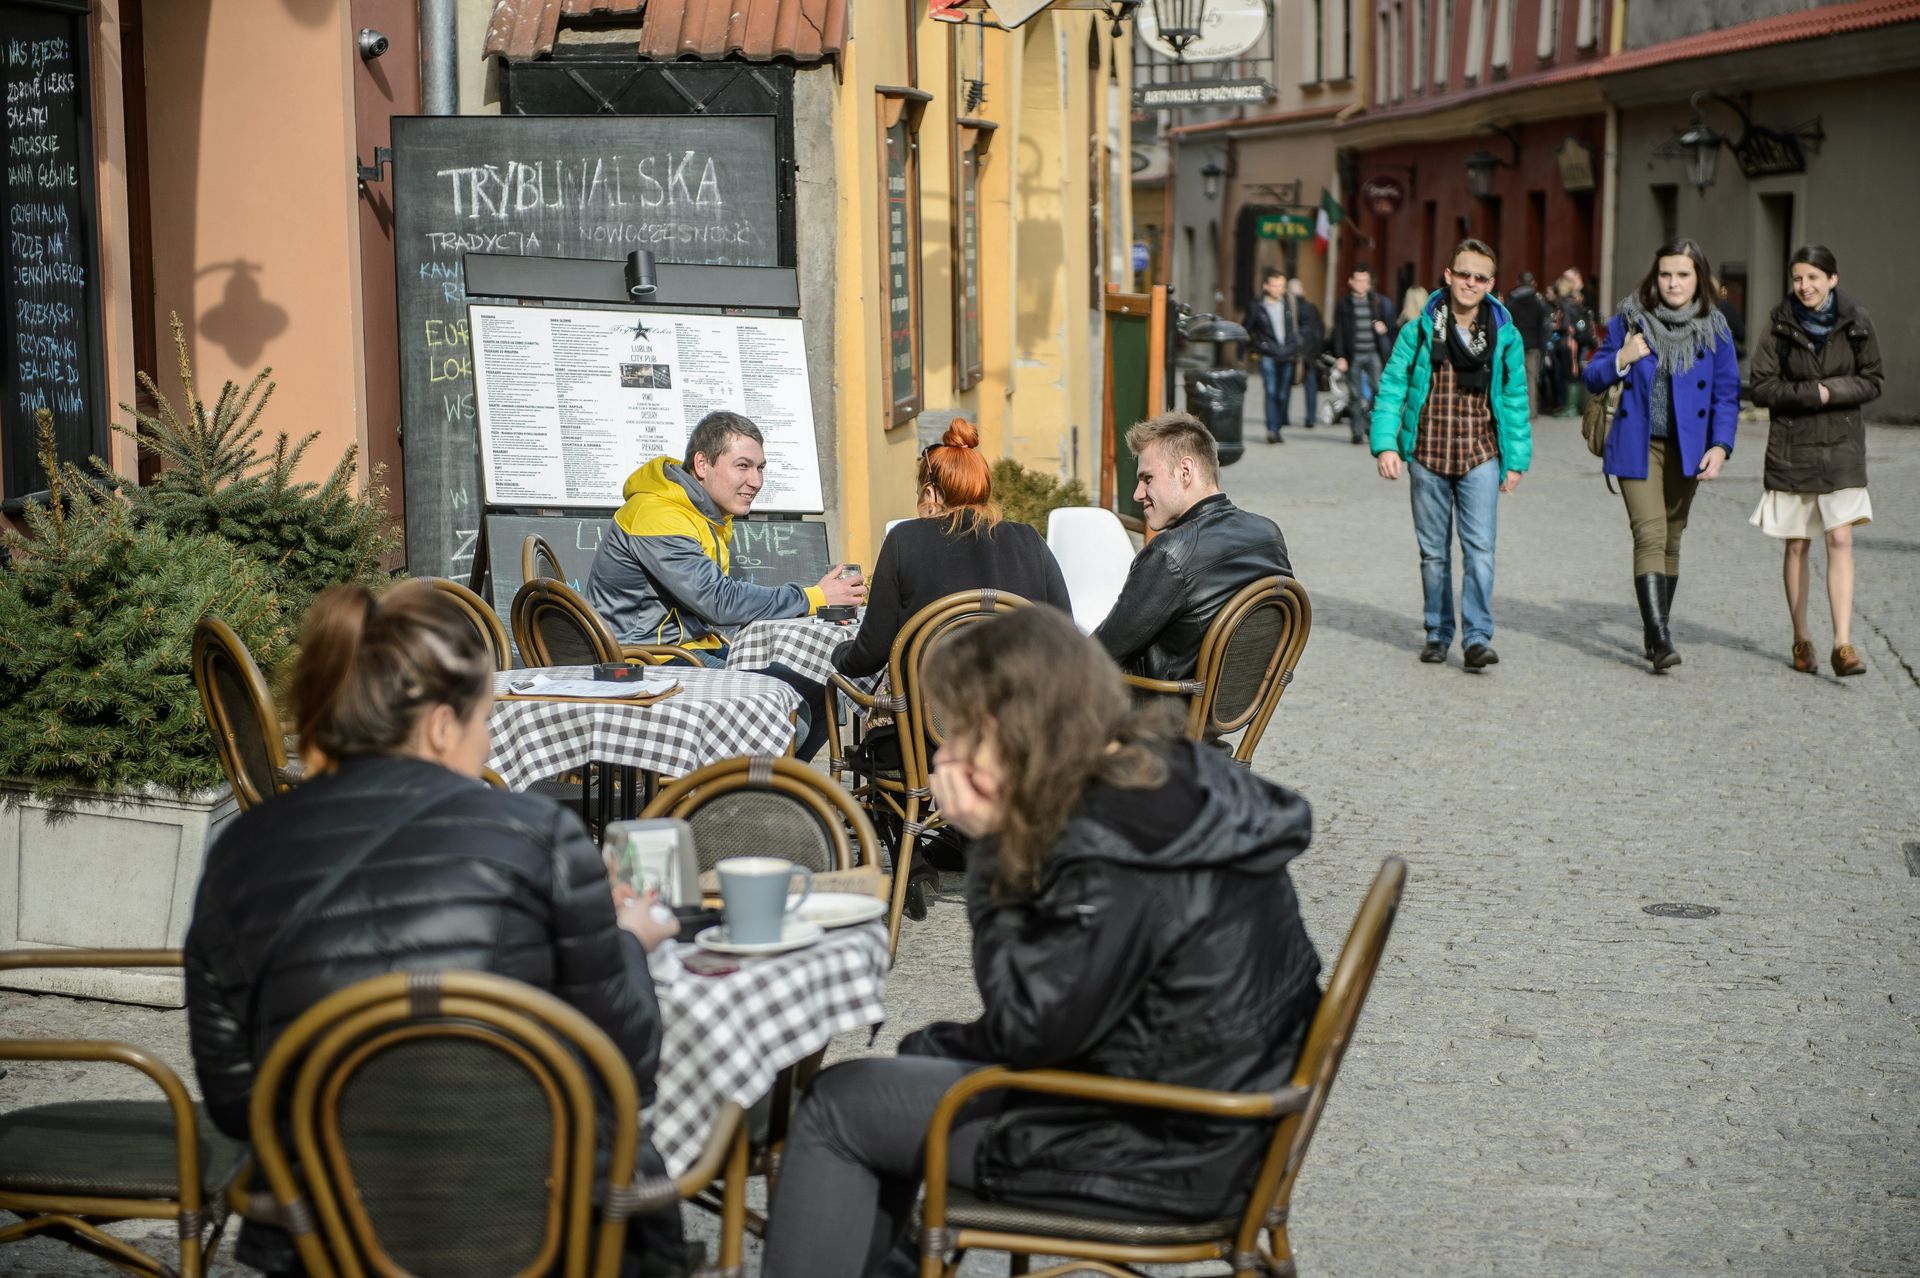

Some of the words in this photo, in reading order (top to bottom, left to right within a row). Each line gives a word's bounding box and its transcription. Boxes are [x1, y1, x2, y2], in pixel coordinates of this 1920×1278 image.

[7, 106, 48, 129] SAŁATKI
[10, 135, 61, 157] AUTORSKIE
[38, 160, 78, 188] GŁÓWNE
[11, 204, 70, 234] ORYGINALNĄ
[11, 230, 43, 266] PIZZĘ
[48, 236, 63, 259] NA
[630, 354, 643, 362] CITY
[644, 355, 657, 363] PUB
[631, 345, 653, 353] LUBLIN
[19, 386, 46, 414] PIWA
